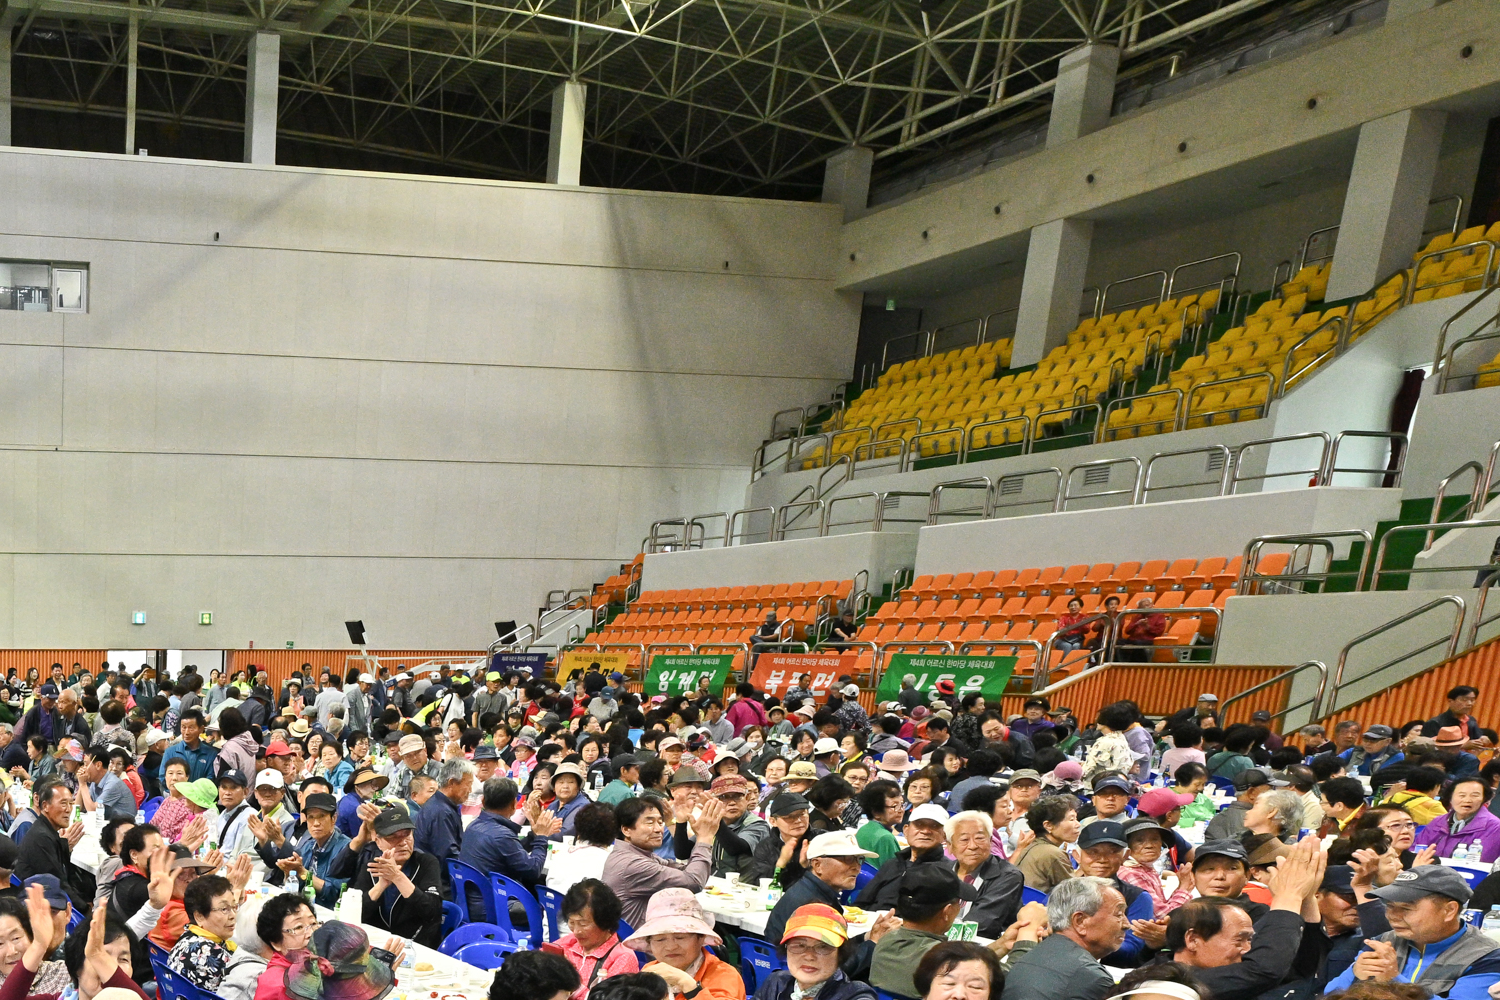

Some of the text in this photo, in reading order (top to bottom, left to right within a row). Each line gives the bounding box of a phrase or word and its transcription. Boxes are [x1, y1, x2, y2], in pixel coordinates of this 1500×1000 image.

[689, 658, 702, 666] 한마당
[702, 658, 720, 666] 체육대회
[772, 657, 841, 667] 제4회 어르신 한마당 체육대회
[909, 658, 996, 669] 제4회 어르신 한마당 체육대회
[899, 673, 986, 702] 동읍
